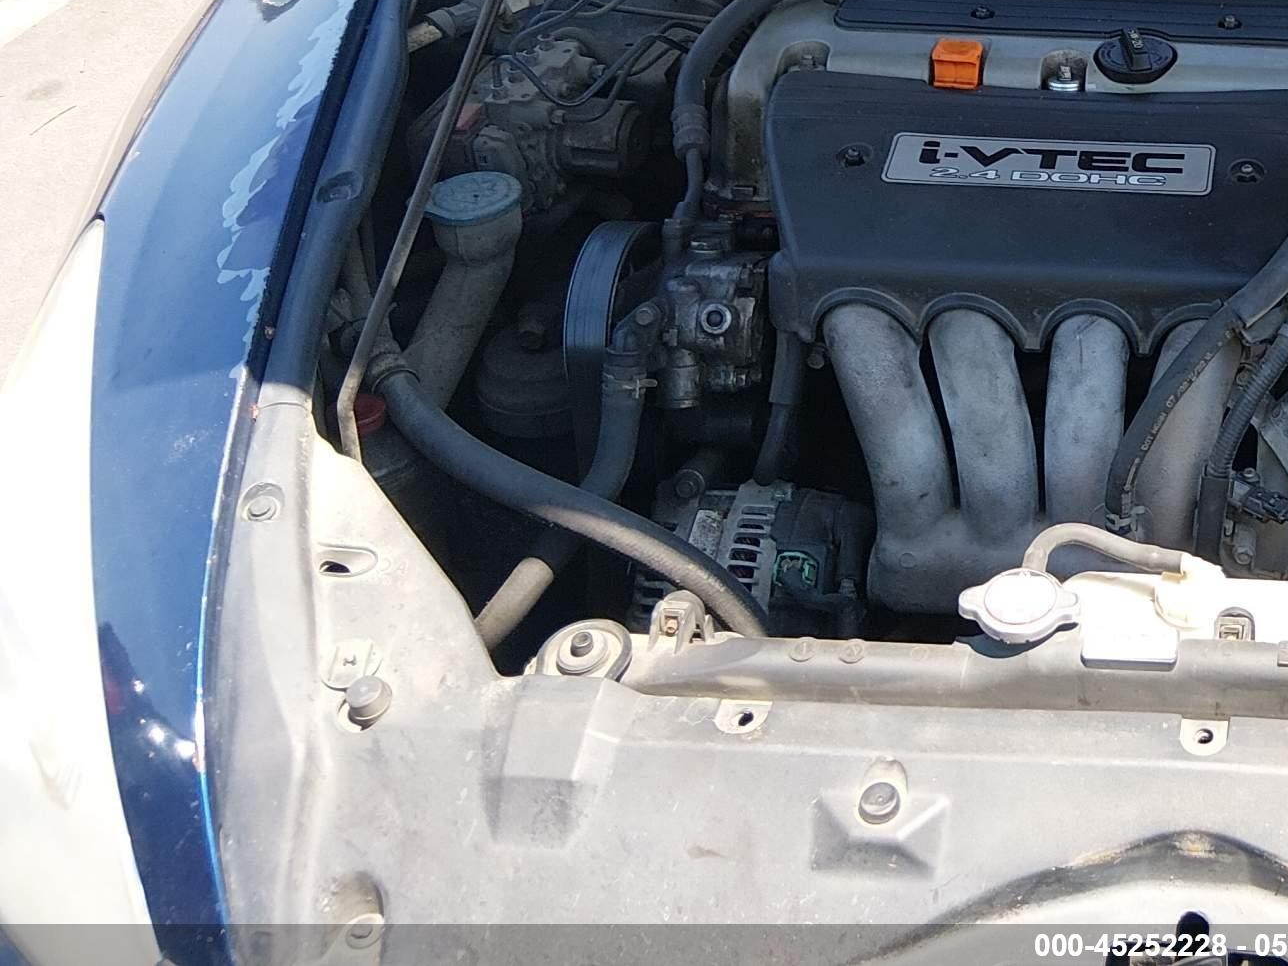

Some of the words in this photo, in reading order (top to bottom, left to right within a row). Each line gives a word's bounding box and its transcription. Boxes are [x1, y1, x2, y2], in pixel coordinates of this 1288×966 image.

[918, 140, 1186, 174] i-VTEC
[929, 167, 1000, 180] 2.4
[1010, 169, 1167, 186] DOHC
